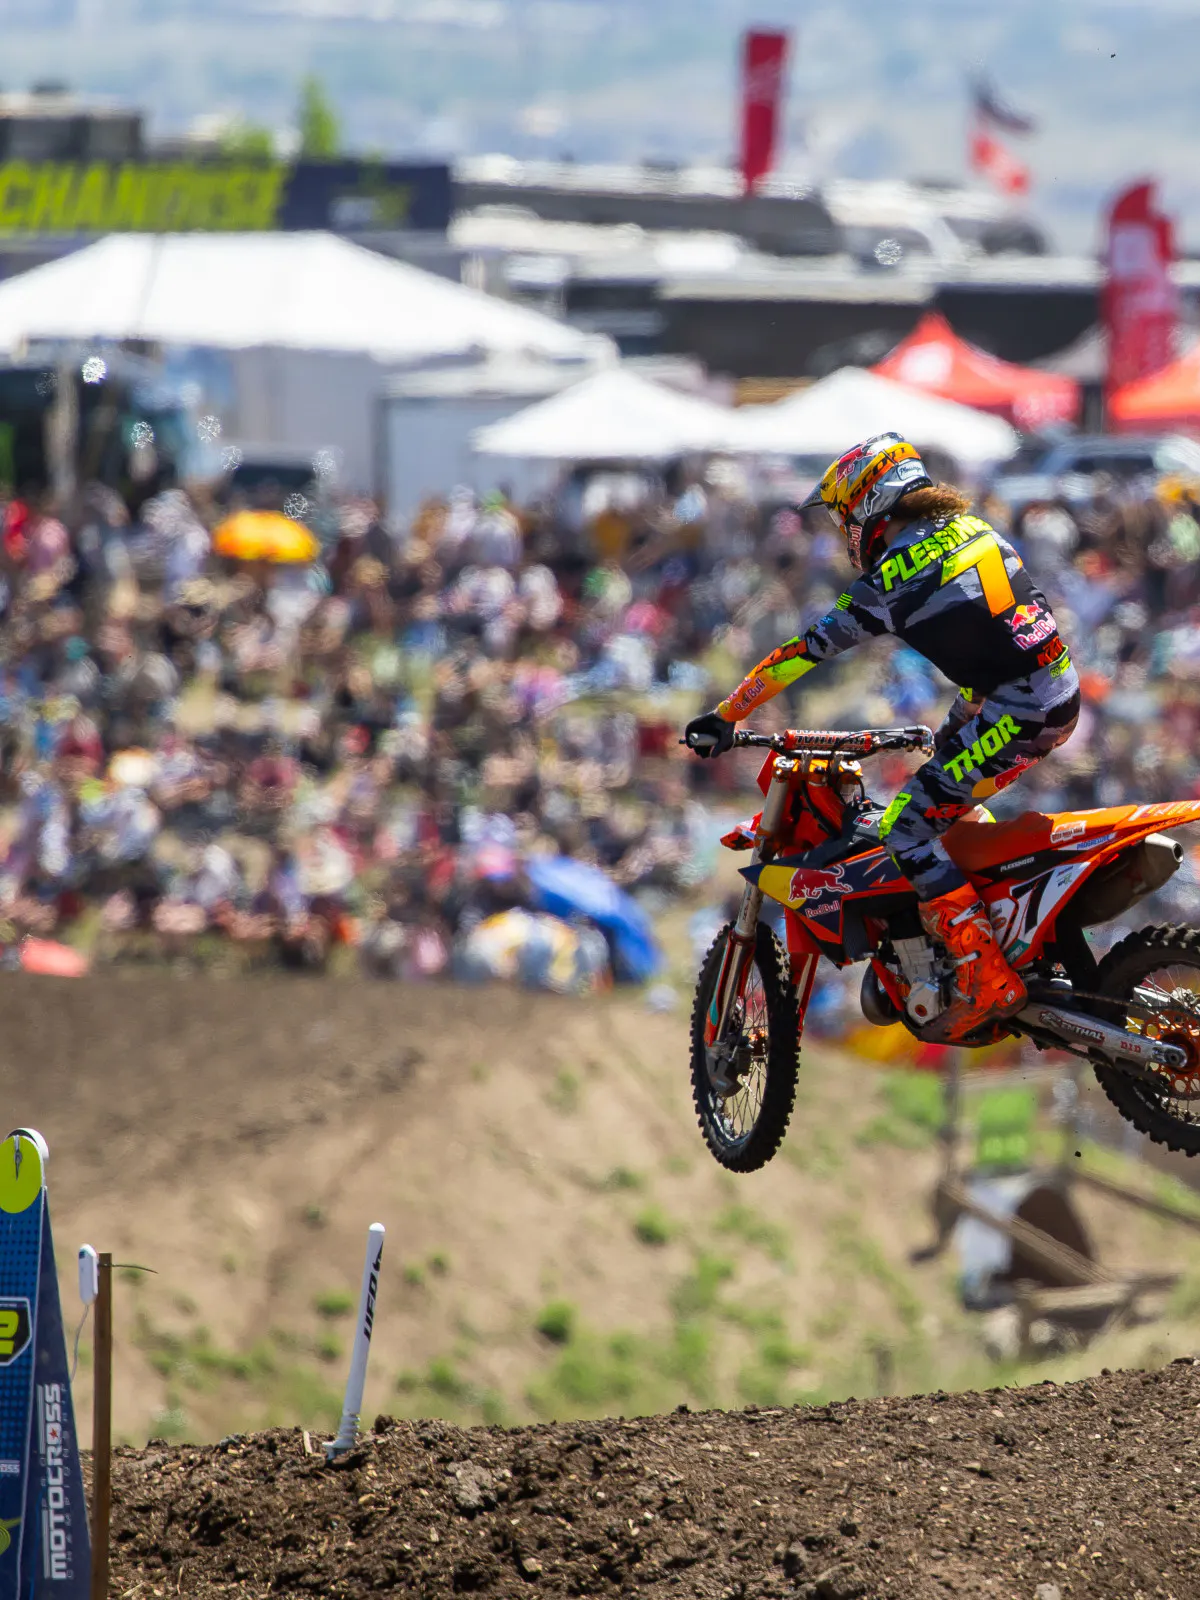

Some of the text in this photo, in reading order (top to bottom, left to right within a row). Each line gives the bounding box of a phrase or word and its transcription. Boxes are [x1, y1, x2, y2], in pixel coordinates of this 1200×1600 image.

[940, 533, 1017, 619] 7
[1013, 623, 1047, 651] Red
[734, 676, 767, 712] Red Bull
[943, 713, 1022, 783] THOR
[805, 900, 841, 918] Red Bull
[363, 1271, 378, 1342] UFO
[44, 1382, 68, 1581] MOTOCROSS
